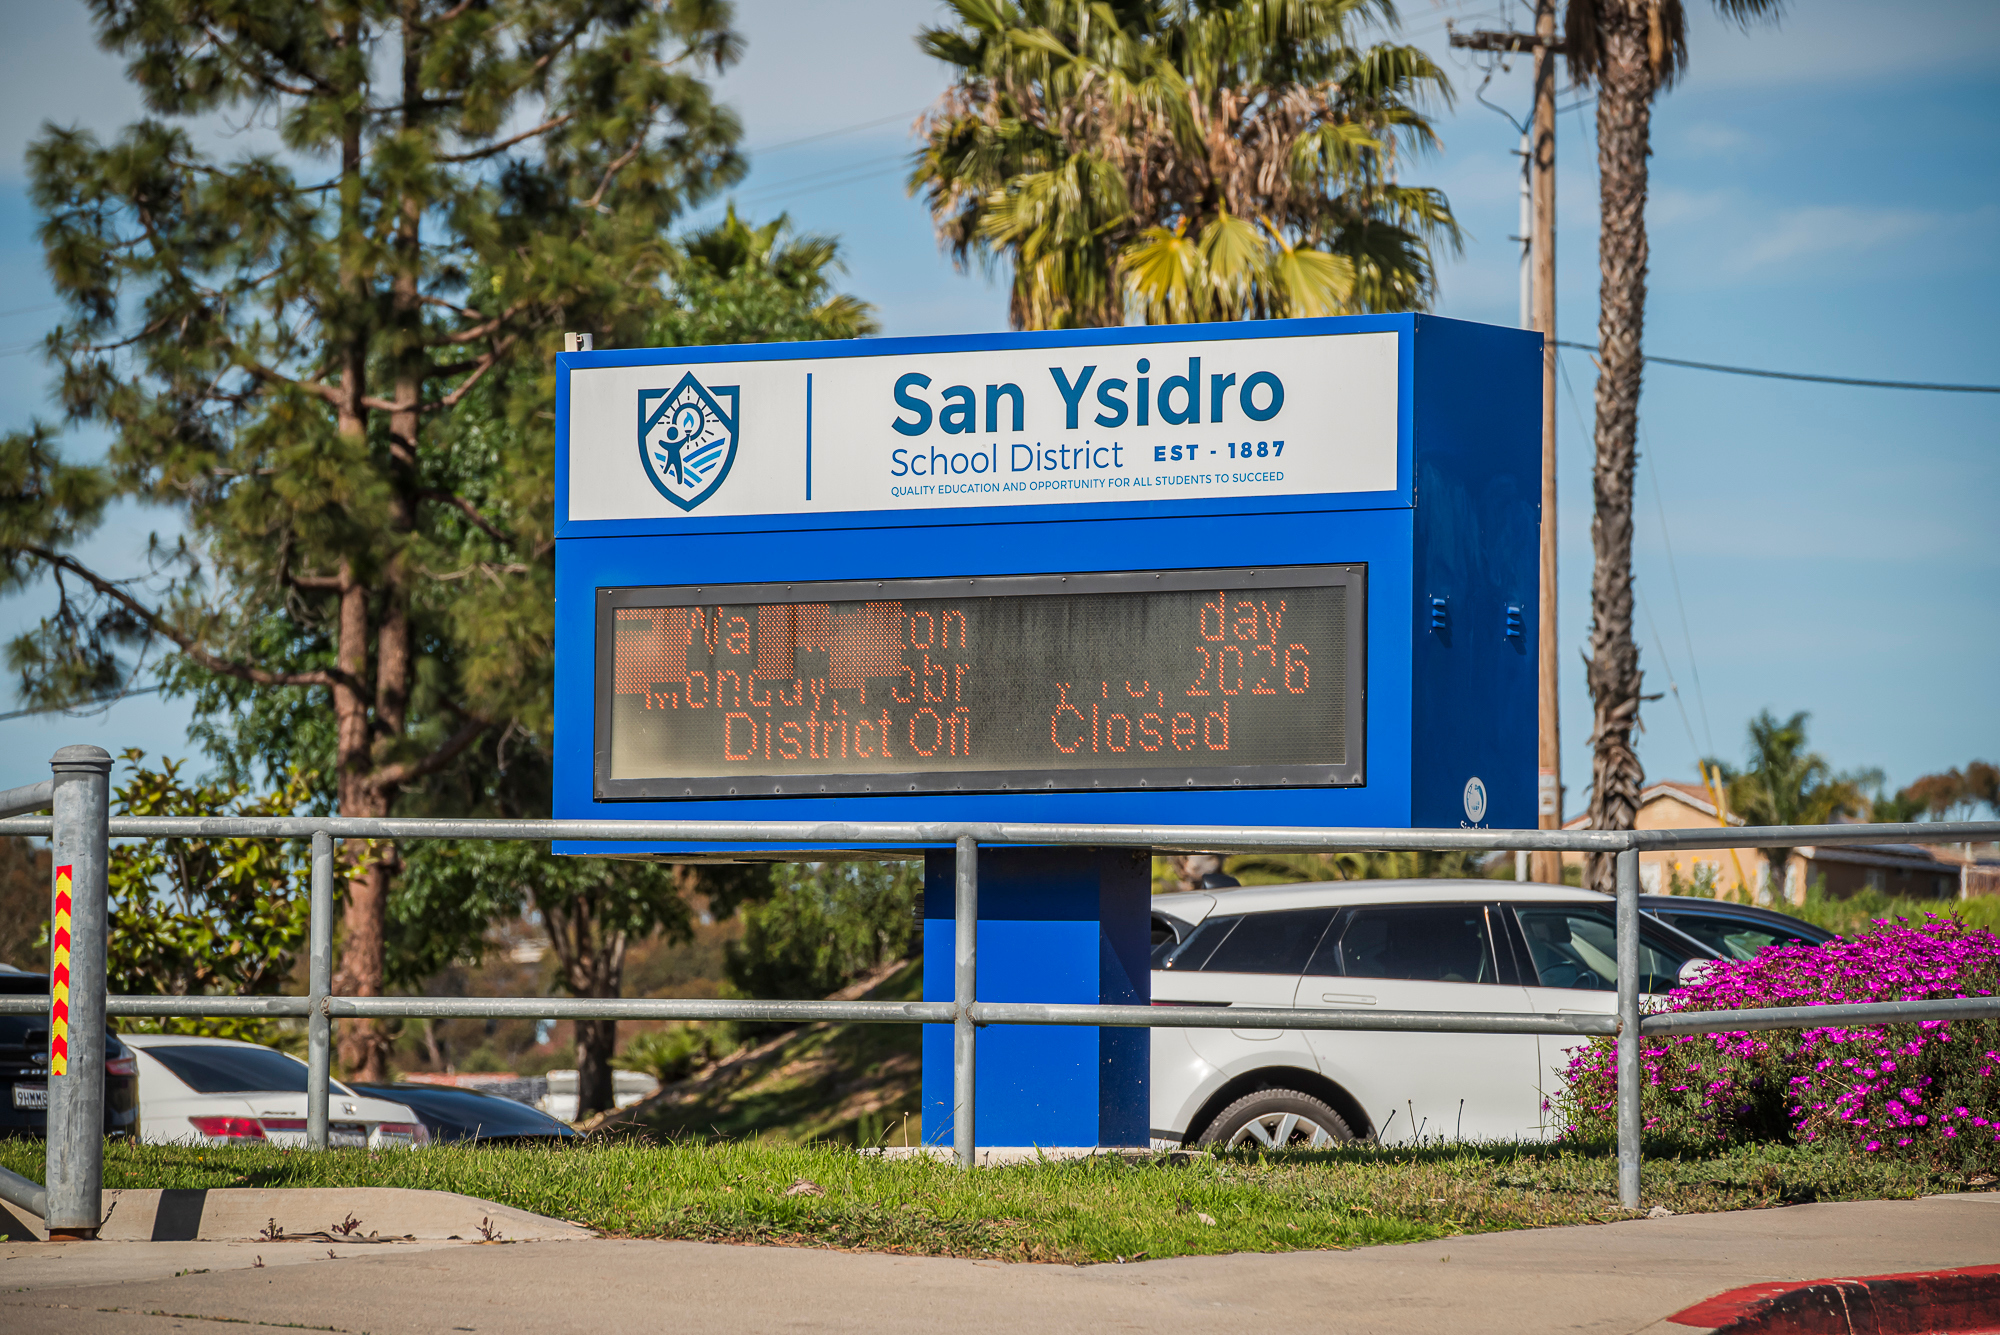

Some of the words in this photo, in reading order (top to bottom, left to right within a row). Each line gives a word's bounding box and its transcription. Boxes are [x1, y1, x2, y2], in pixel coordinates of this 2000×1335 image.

[891, 372, 1025, 437] San
[1048, 356, 1285, 430] Ysidro
[890, 443, 998, 477] School
[1011, 439, 1124, 473] District
[1153, 443, 1199, 462] EST
[1227, 440, 1285, 459] 1887
[890, 485, 935, 498] QUALITY
[938, 482, 1000, 495] EDUCATION
[1002, 481, 1027, 493] AND
[1029, 478, 1106, 491] OPPORTUNITY
[1108, 477, 1131, 488] FOR
[1132, 476, 1153, 487] ALL
[1155, 474, 1212, 486] STUDENTS
[1214, 473, 1230, 484] TO
[1232, 471, 1285, 483] SUCCEED
[1186, 643, 1310, 696] 2026
[725, 708, 893, 761] District
[1051, 700, 1230, 753] Closed
